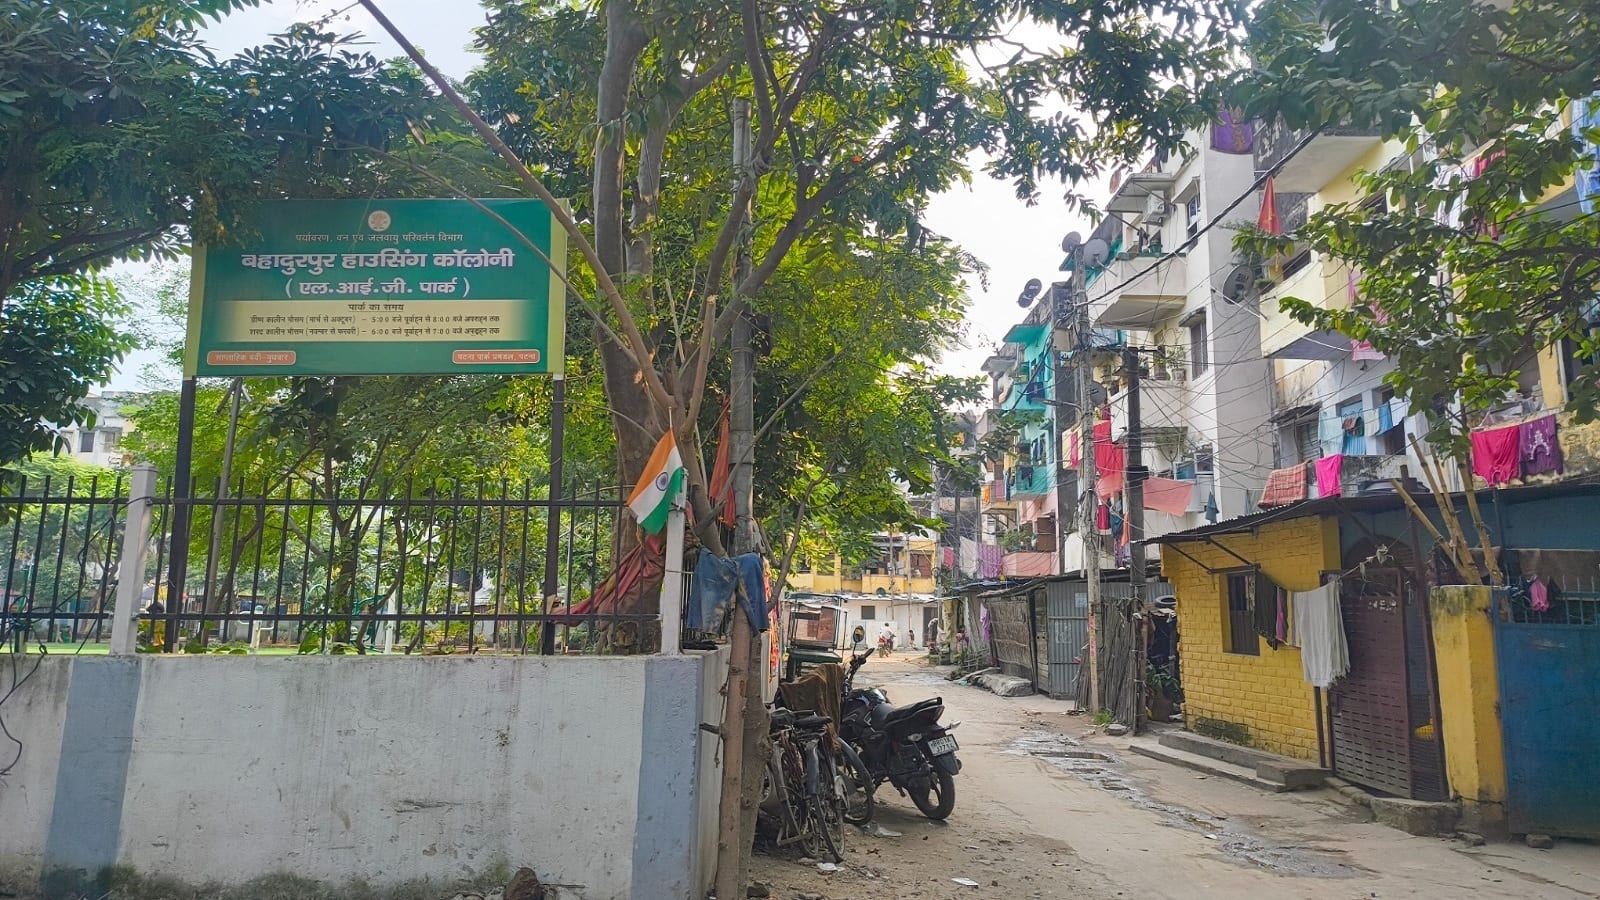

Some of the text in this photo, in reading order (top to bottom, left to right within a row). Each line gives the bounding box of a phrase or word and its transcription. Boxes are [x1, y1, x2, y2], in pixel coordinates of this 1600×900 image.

[336, 234, 349, 242] वन
[368, 234, 399, 245] जलवायु
[402, 232, 435, 242] परिवर्तन
[438, 232, 463, 242] विभाग
[241, 248, 516, 275] बहादुरपुर हाउसिंग कॉलोनी
[348, 303, 365, 311] पार्क
